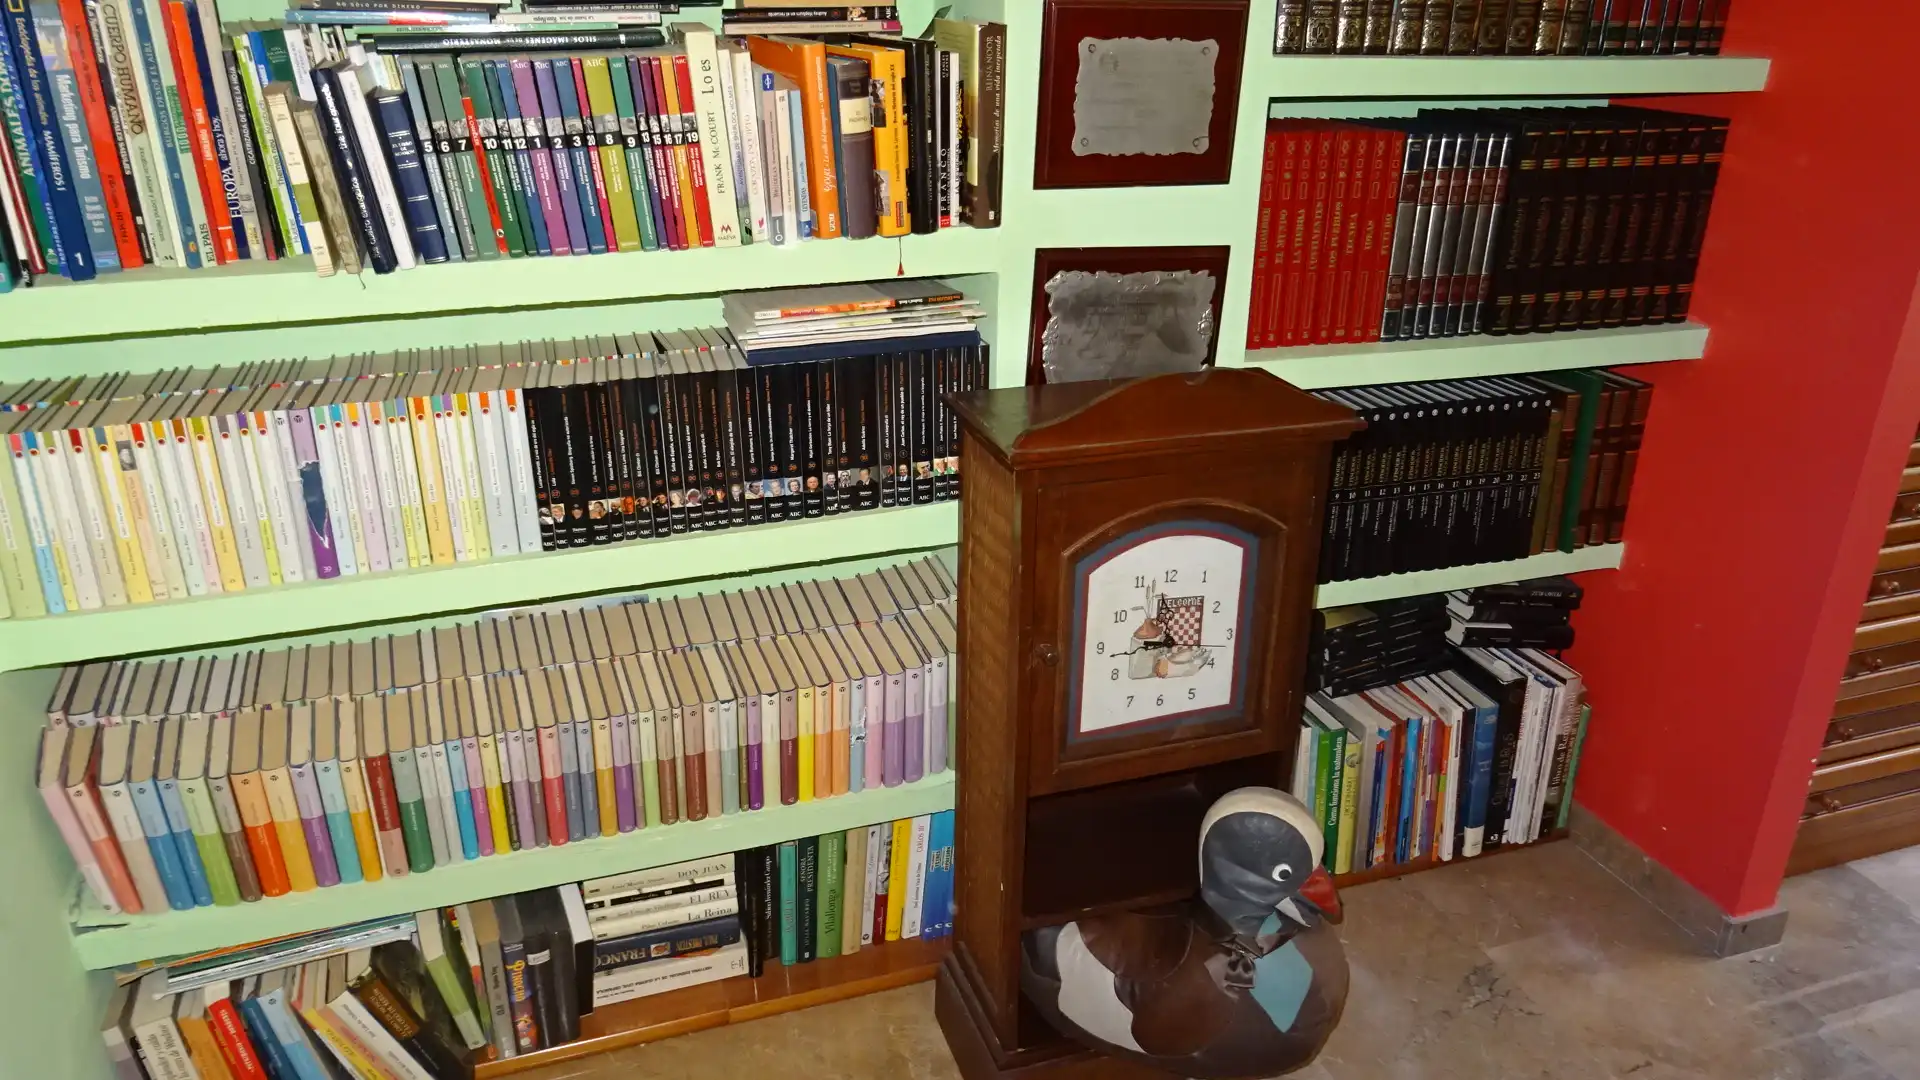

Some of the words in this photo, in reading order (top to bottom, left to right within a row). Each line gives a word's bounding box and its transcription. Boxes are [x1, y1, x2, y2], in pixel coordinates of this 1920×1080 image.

[985, 35, 993, 63] NOOR
[995, 35, 1004, 72] inesperada
[101, 2, 128, 64] CUERPO
[116, 64, 145, 135] HUMANO
[699, 58, 712, 71] es
[985, 65, 993, 90] REINA
[994, 74, 1002, 90] vida
[53, 72, 80, 121] Marketing
[150, 76, 164, 108] DESDE
[726, 85, 735, 110] HOLMES
[235, 95, 244, 113] ARTE
[239, 113, 247, 123] DE
[730, 111, 739, 141] SHERLOCK
[65, 122, 81, 144] para
[605, 134, 613, 144] 8
[642, 132, 650, 143] 13
[664, 134, 672, 144] 16
[674, 134, 683, 144] 17
[686, 132, 698, 142] 19
[992, 119, 1000, 152] Memorias
[241, 123, 256, 164] CICATRIZADA
[458, 140, 466, 150] 7
[484, 138, 497, 149] 10
[501, 138, 513, 150] 11
[514, 138, 527, 149] 12
[534, 138, 541, 148] 1
[554, 138, 562, 148] 2
[573, 136, 581, 146] 3
[588, 135, 595, 145] 20
[627, 137, 636, 147] 9
[652, 135, 661, 145] 15
[734, 142, 741, 150] DE
[214, 138, 228, 161] ahora
[424, 142, 433, 152] 5
[441, 142, 450, 152] 6
[41, 127, 66, 186] MAMÍFEROS
[72, 143, 94, 180] Turismo
[735, 150, 746, 185] AVENTURAS
[713, 163, 725, 194] FRANK
[349, 176, 369, 218] evangelios
[1276, 208, 1287, 248] MUNDO
[204, 247, 215, 262] EL
[1275, 251, 1284, 264] EL
[1135, 576, 1145, 588] 11
[1164, 570, 1178, 583] 12
[1202, 570, 1207, 582] 1
[1160, 597, 1202, 608] WELCOME
[1212, 601, 1221, 613] 2
[1114, 610, 1127, 623] 10
[1226, 628, 1233, 640] 3
[1096, 642, 1104, 654] 9
[1207, 657, 1215, 668] 4
[1111, 668, 1119, 680] 8
[1156, 694, 1164, 706] 6
[1188, 688, 1196, 700] 5
[1126, 696, 1134, 708] 7
[1332, 735, 1343, 770] naturaleza
[1329, 777, 1339, 806] funciona
[676, 867, 698, 878] DON
[700, 862, 726, 873] JUAN
[688, 894, 701, 904] EL
[707, 888, 731, 900] REY
[686, 910, 701, 921] La
[703, 904, 732, 917] Reina
[824, 888, 838, 934] Vilallonga
[506, 958, 526, 1004] PINOCHO
[634, 978, 653, 986] GUERRA
